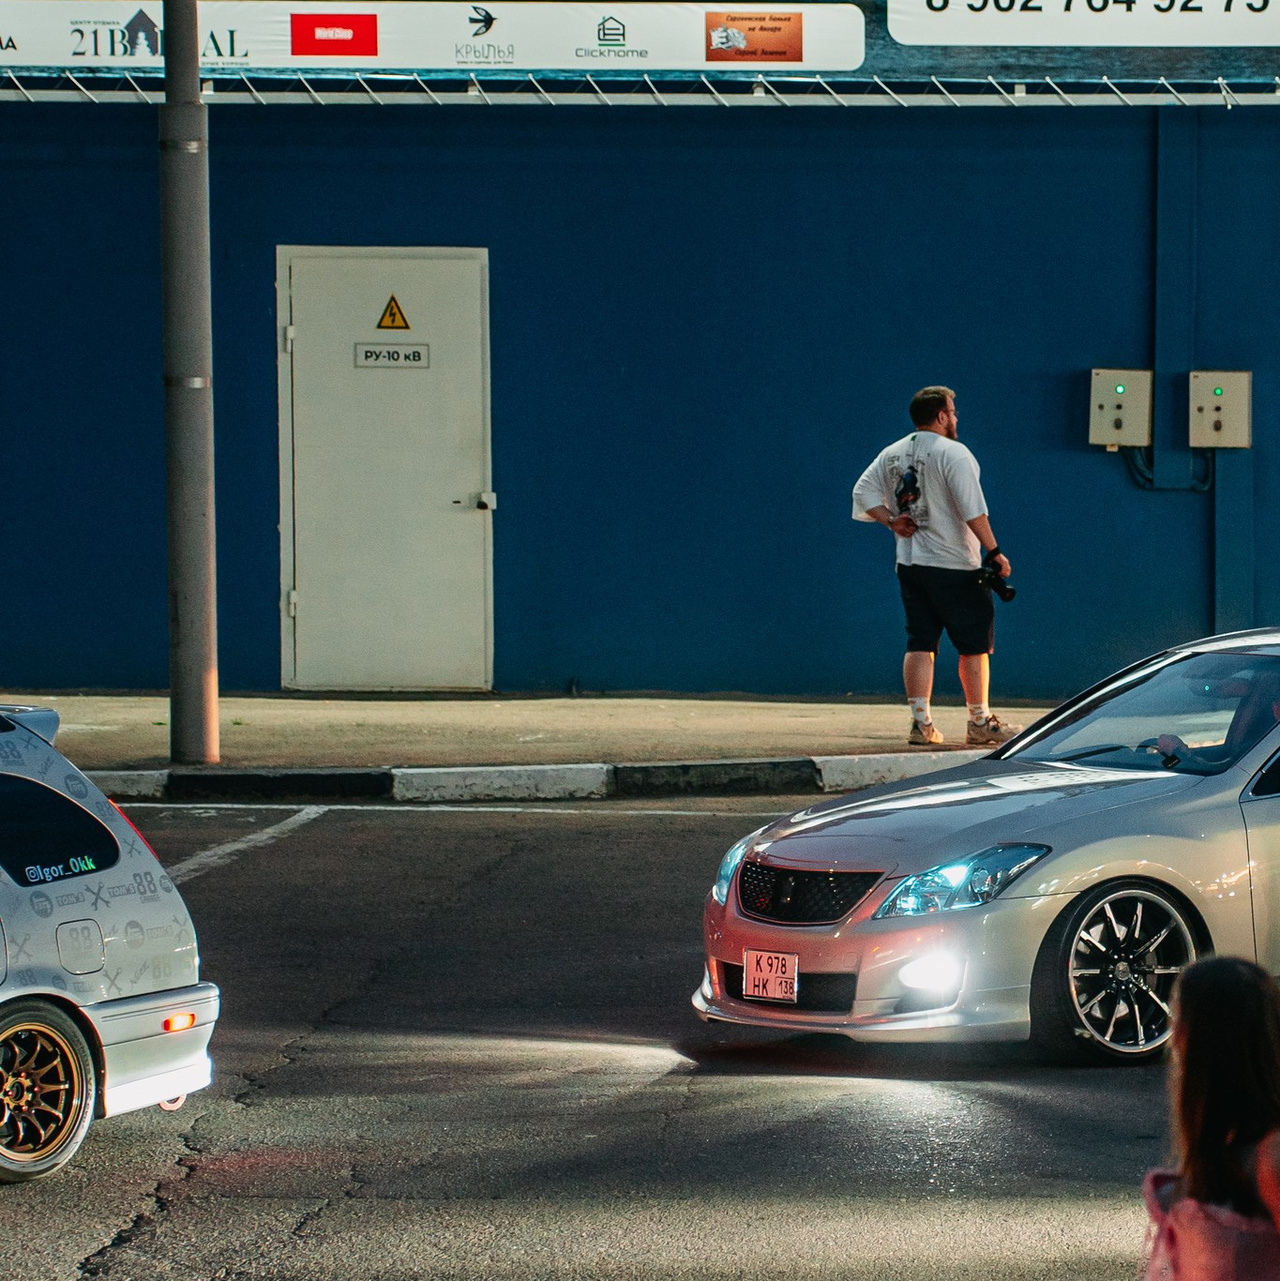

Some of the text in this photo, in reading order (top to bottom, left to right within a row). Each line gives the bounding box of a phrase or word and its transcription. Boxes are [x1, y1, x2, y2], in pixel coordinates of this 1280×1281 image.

[455, 43, 514, 59] КРЫЛЬЯ
[575, 48, 649, 58] Clickhome
[364, 350, 422, 362] РУ-10 кВ
[766, 956, 787, 975] 978
[779, 980, 794, 995] 138
